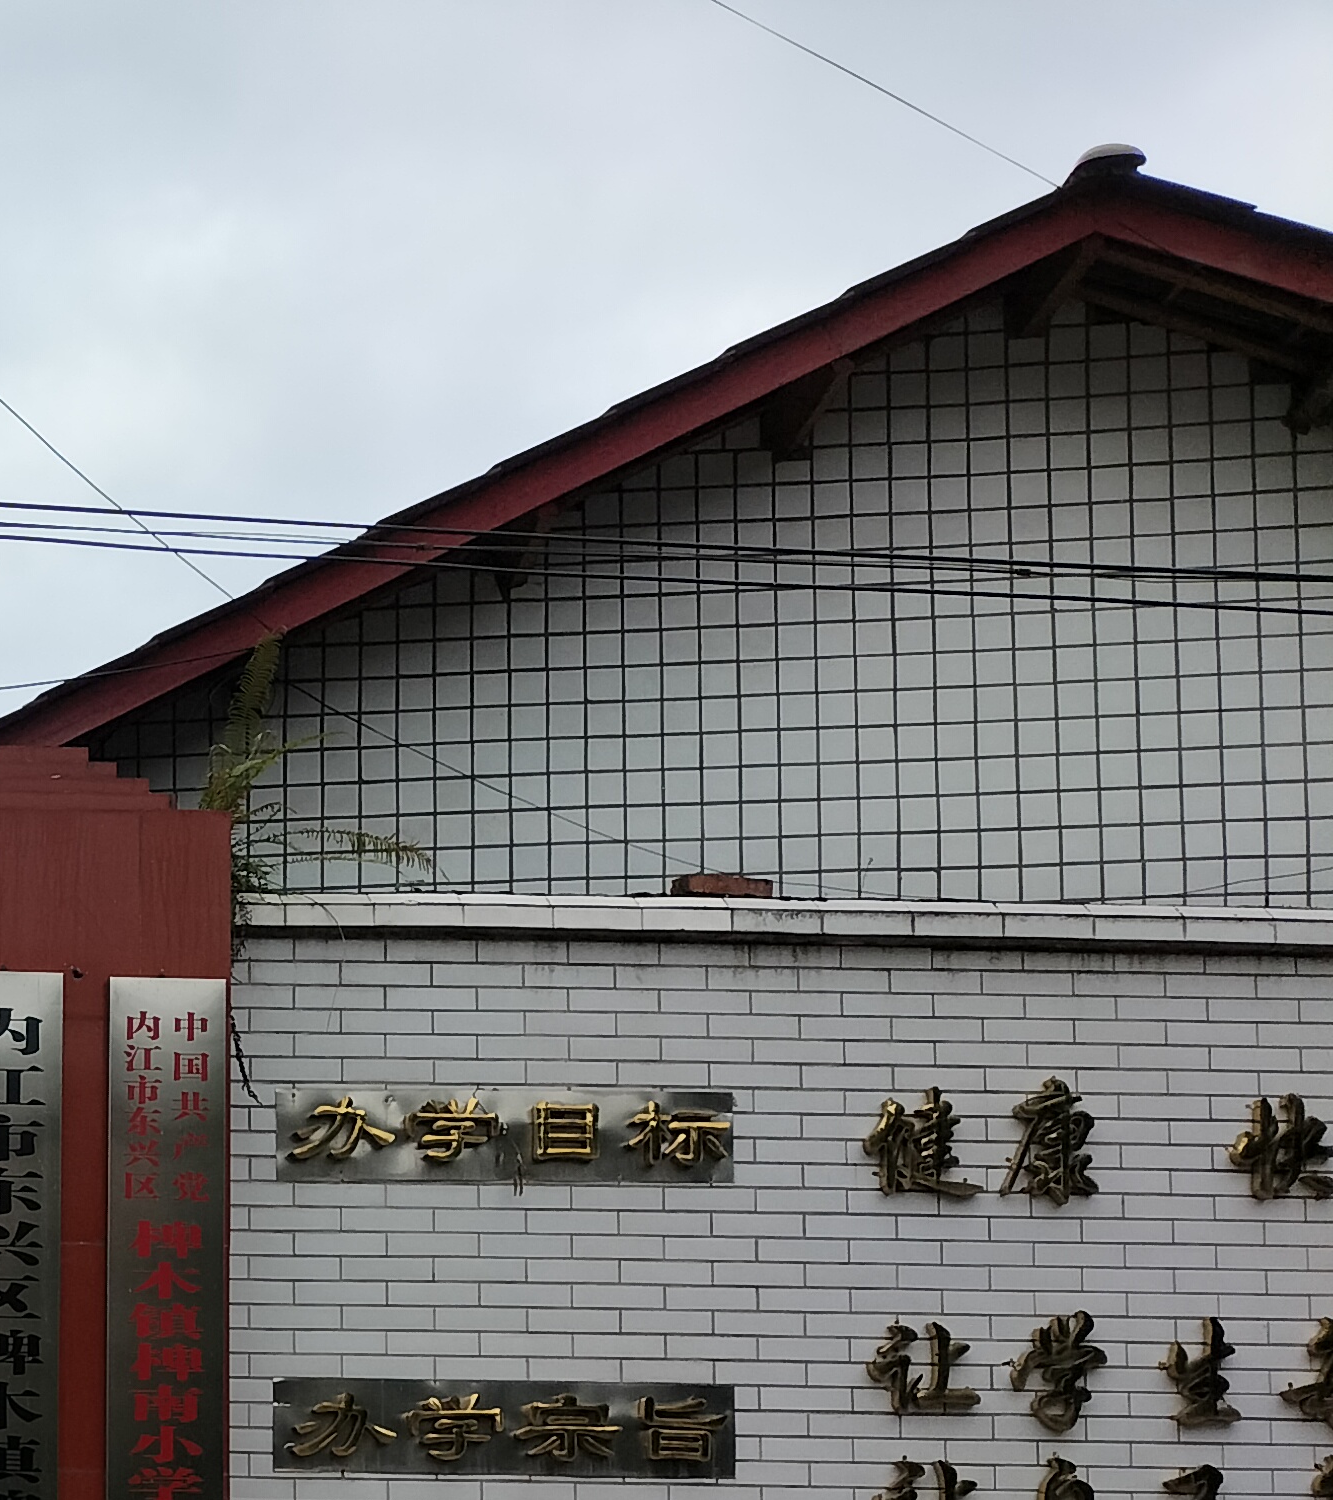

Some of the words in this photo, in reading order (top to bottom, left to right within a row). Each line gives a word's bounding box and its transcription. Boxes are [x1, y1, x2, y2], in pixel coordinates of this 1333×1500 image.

[123, 1010, 164, 1201] 内江市东兴区
[171, 1011, 211, 1203] 中国共产党
[286, 1095, 732, 1167] 办学目标
[862, 1076, 1101, 1207] 健康
[285, 1392, 730, 1464] 办学宗旨
